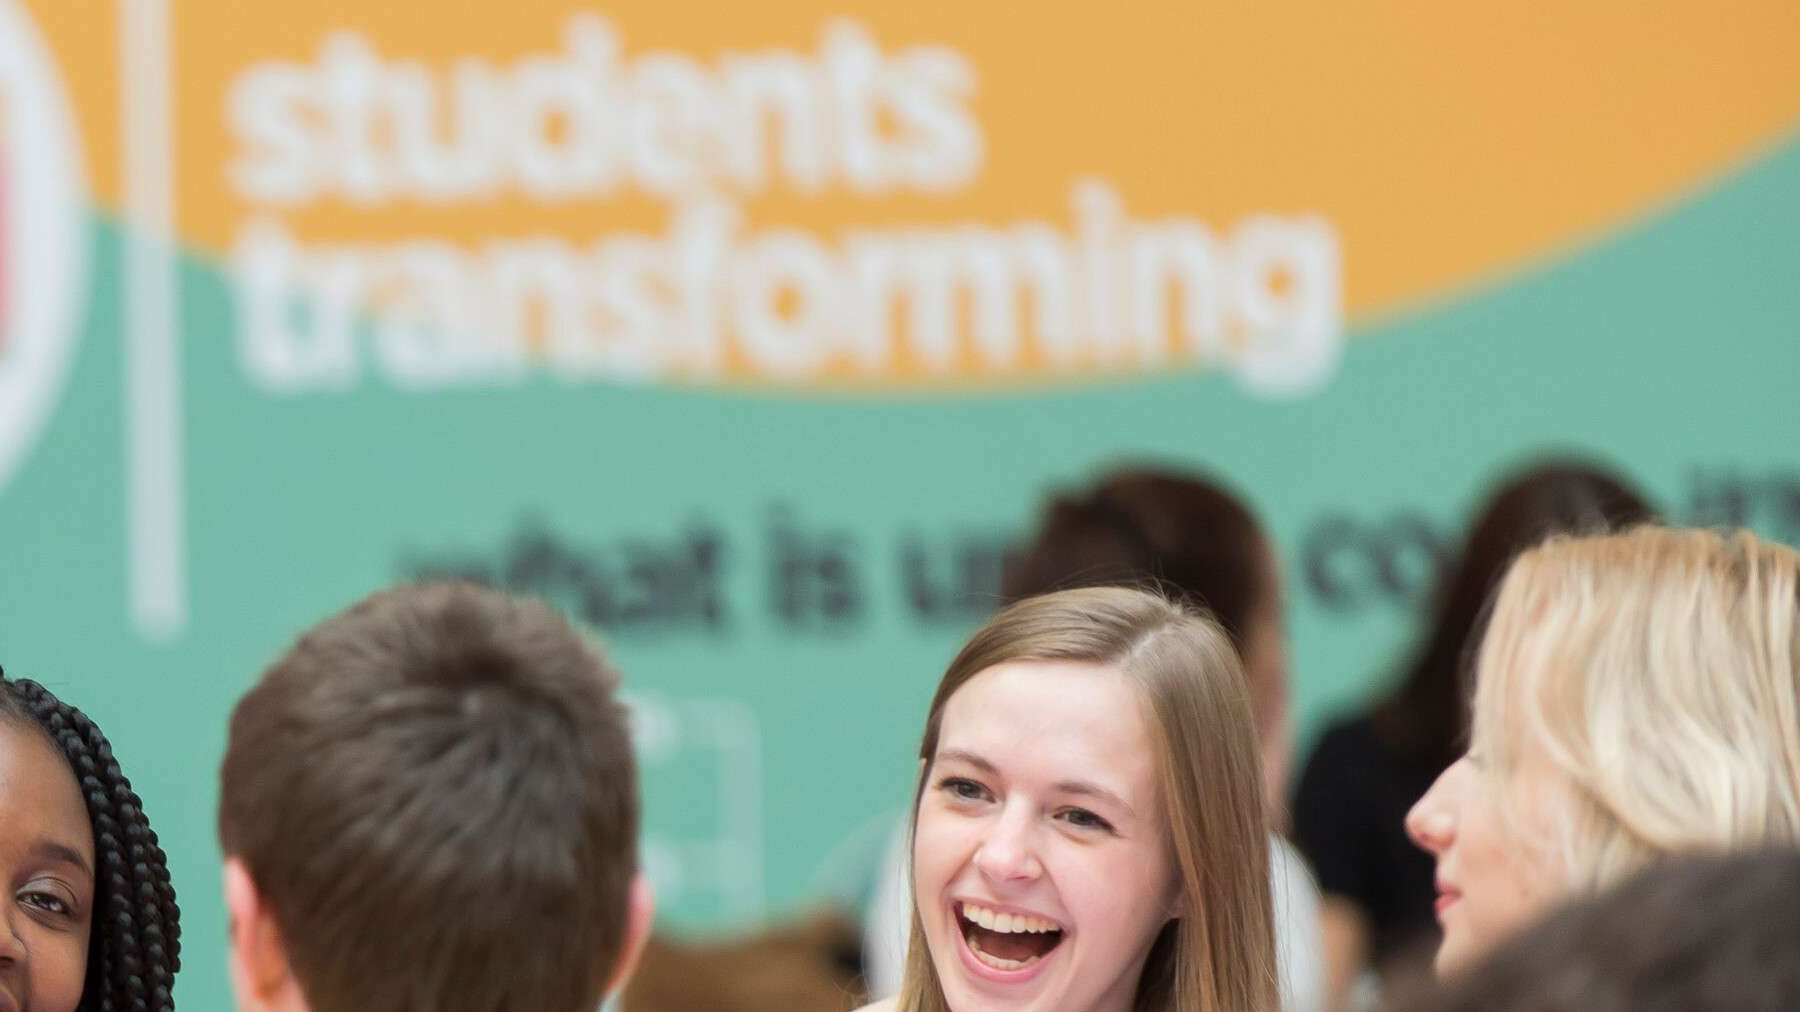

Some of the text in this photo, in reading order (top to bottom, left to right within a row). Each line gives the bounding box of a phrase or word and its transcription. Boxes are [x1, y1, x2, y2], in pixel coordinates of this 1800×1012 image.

[228, 14, 980, 202] students
[232, 180, 1341, 394] transforming
[762, 499, 865, 635] is
